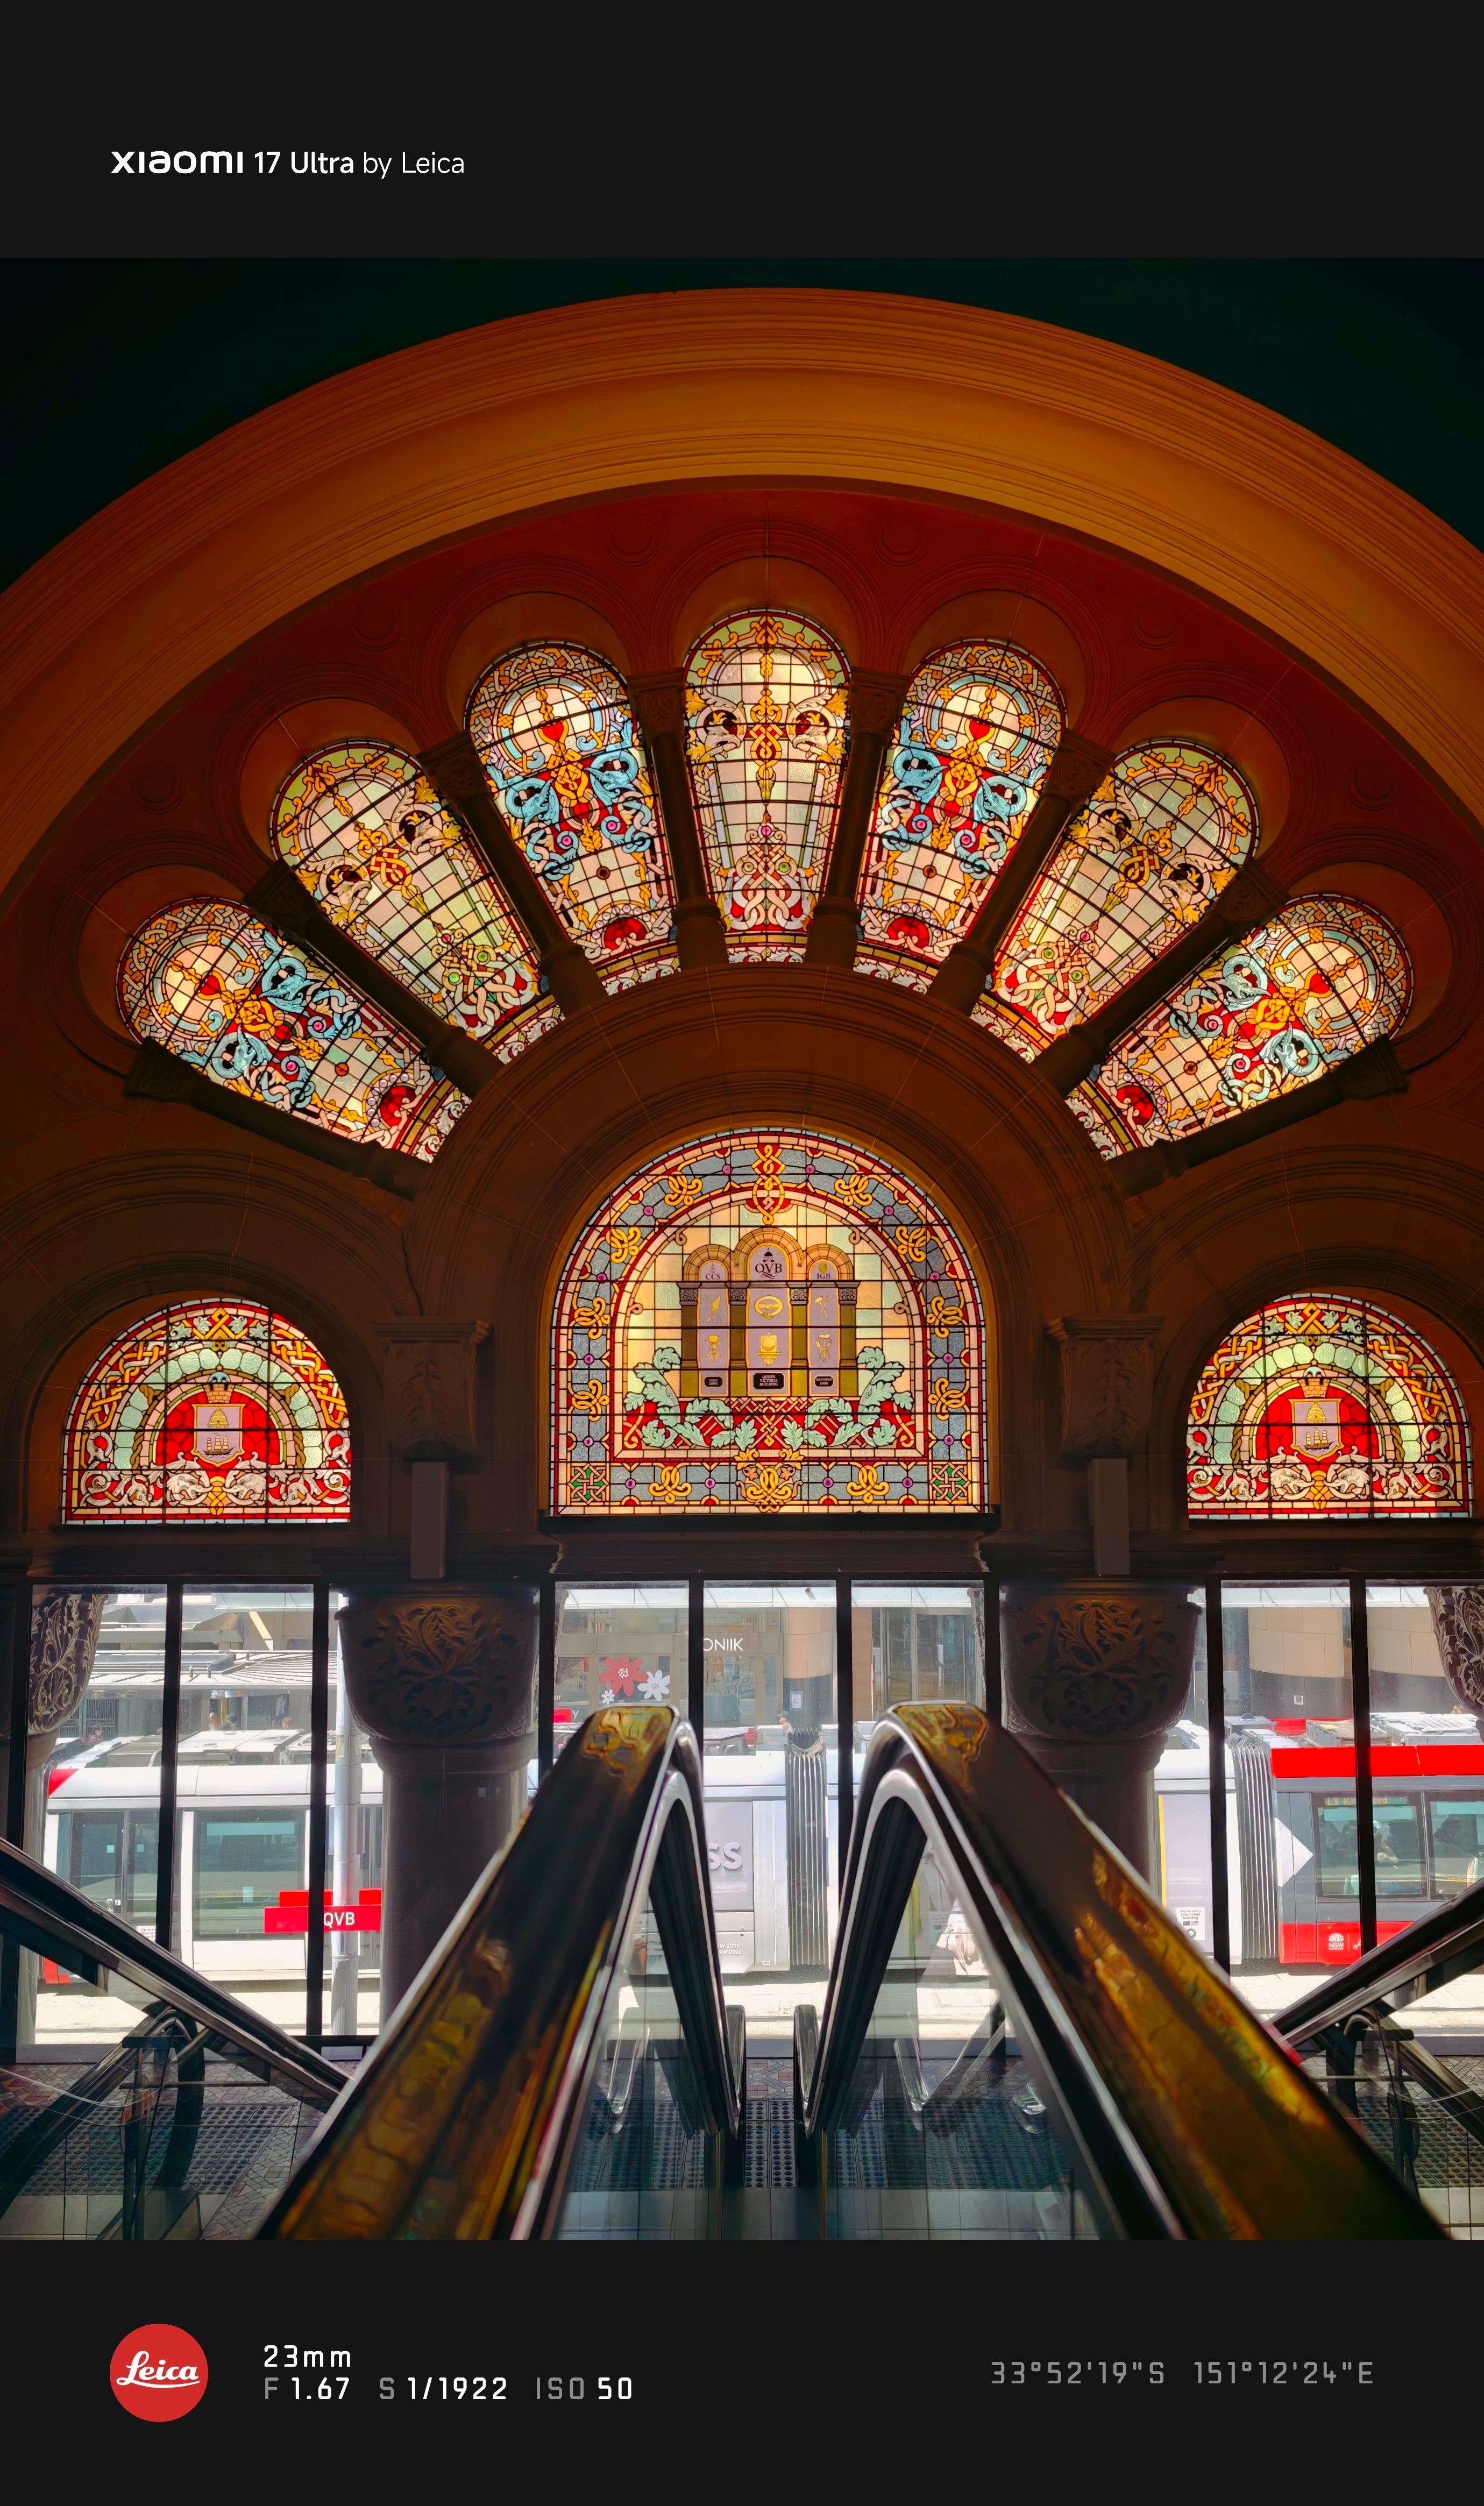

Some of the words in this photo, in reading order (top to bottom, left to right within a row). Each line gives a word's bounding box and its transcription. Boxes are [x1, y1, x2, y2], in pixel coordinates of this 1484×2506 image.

[755, 1263, 783, 1279] QVB
[1327, 1797, 1339, 1806] L3
[324, 1912, 355, 1928] QVB
